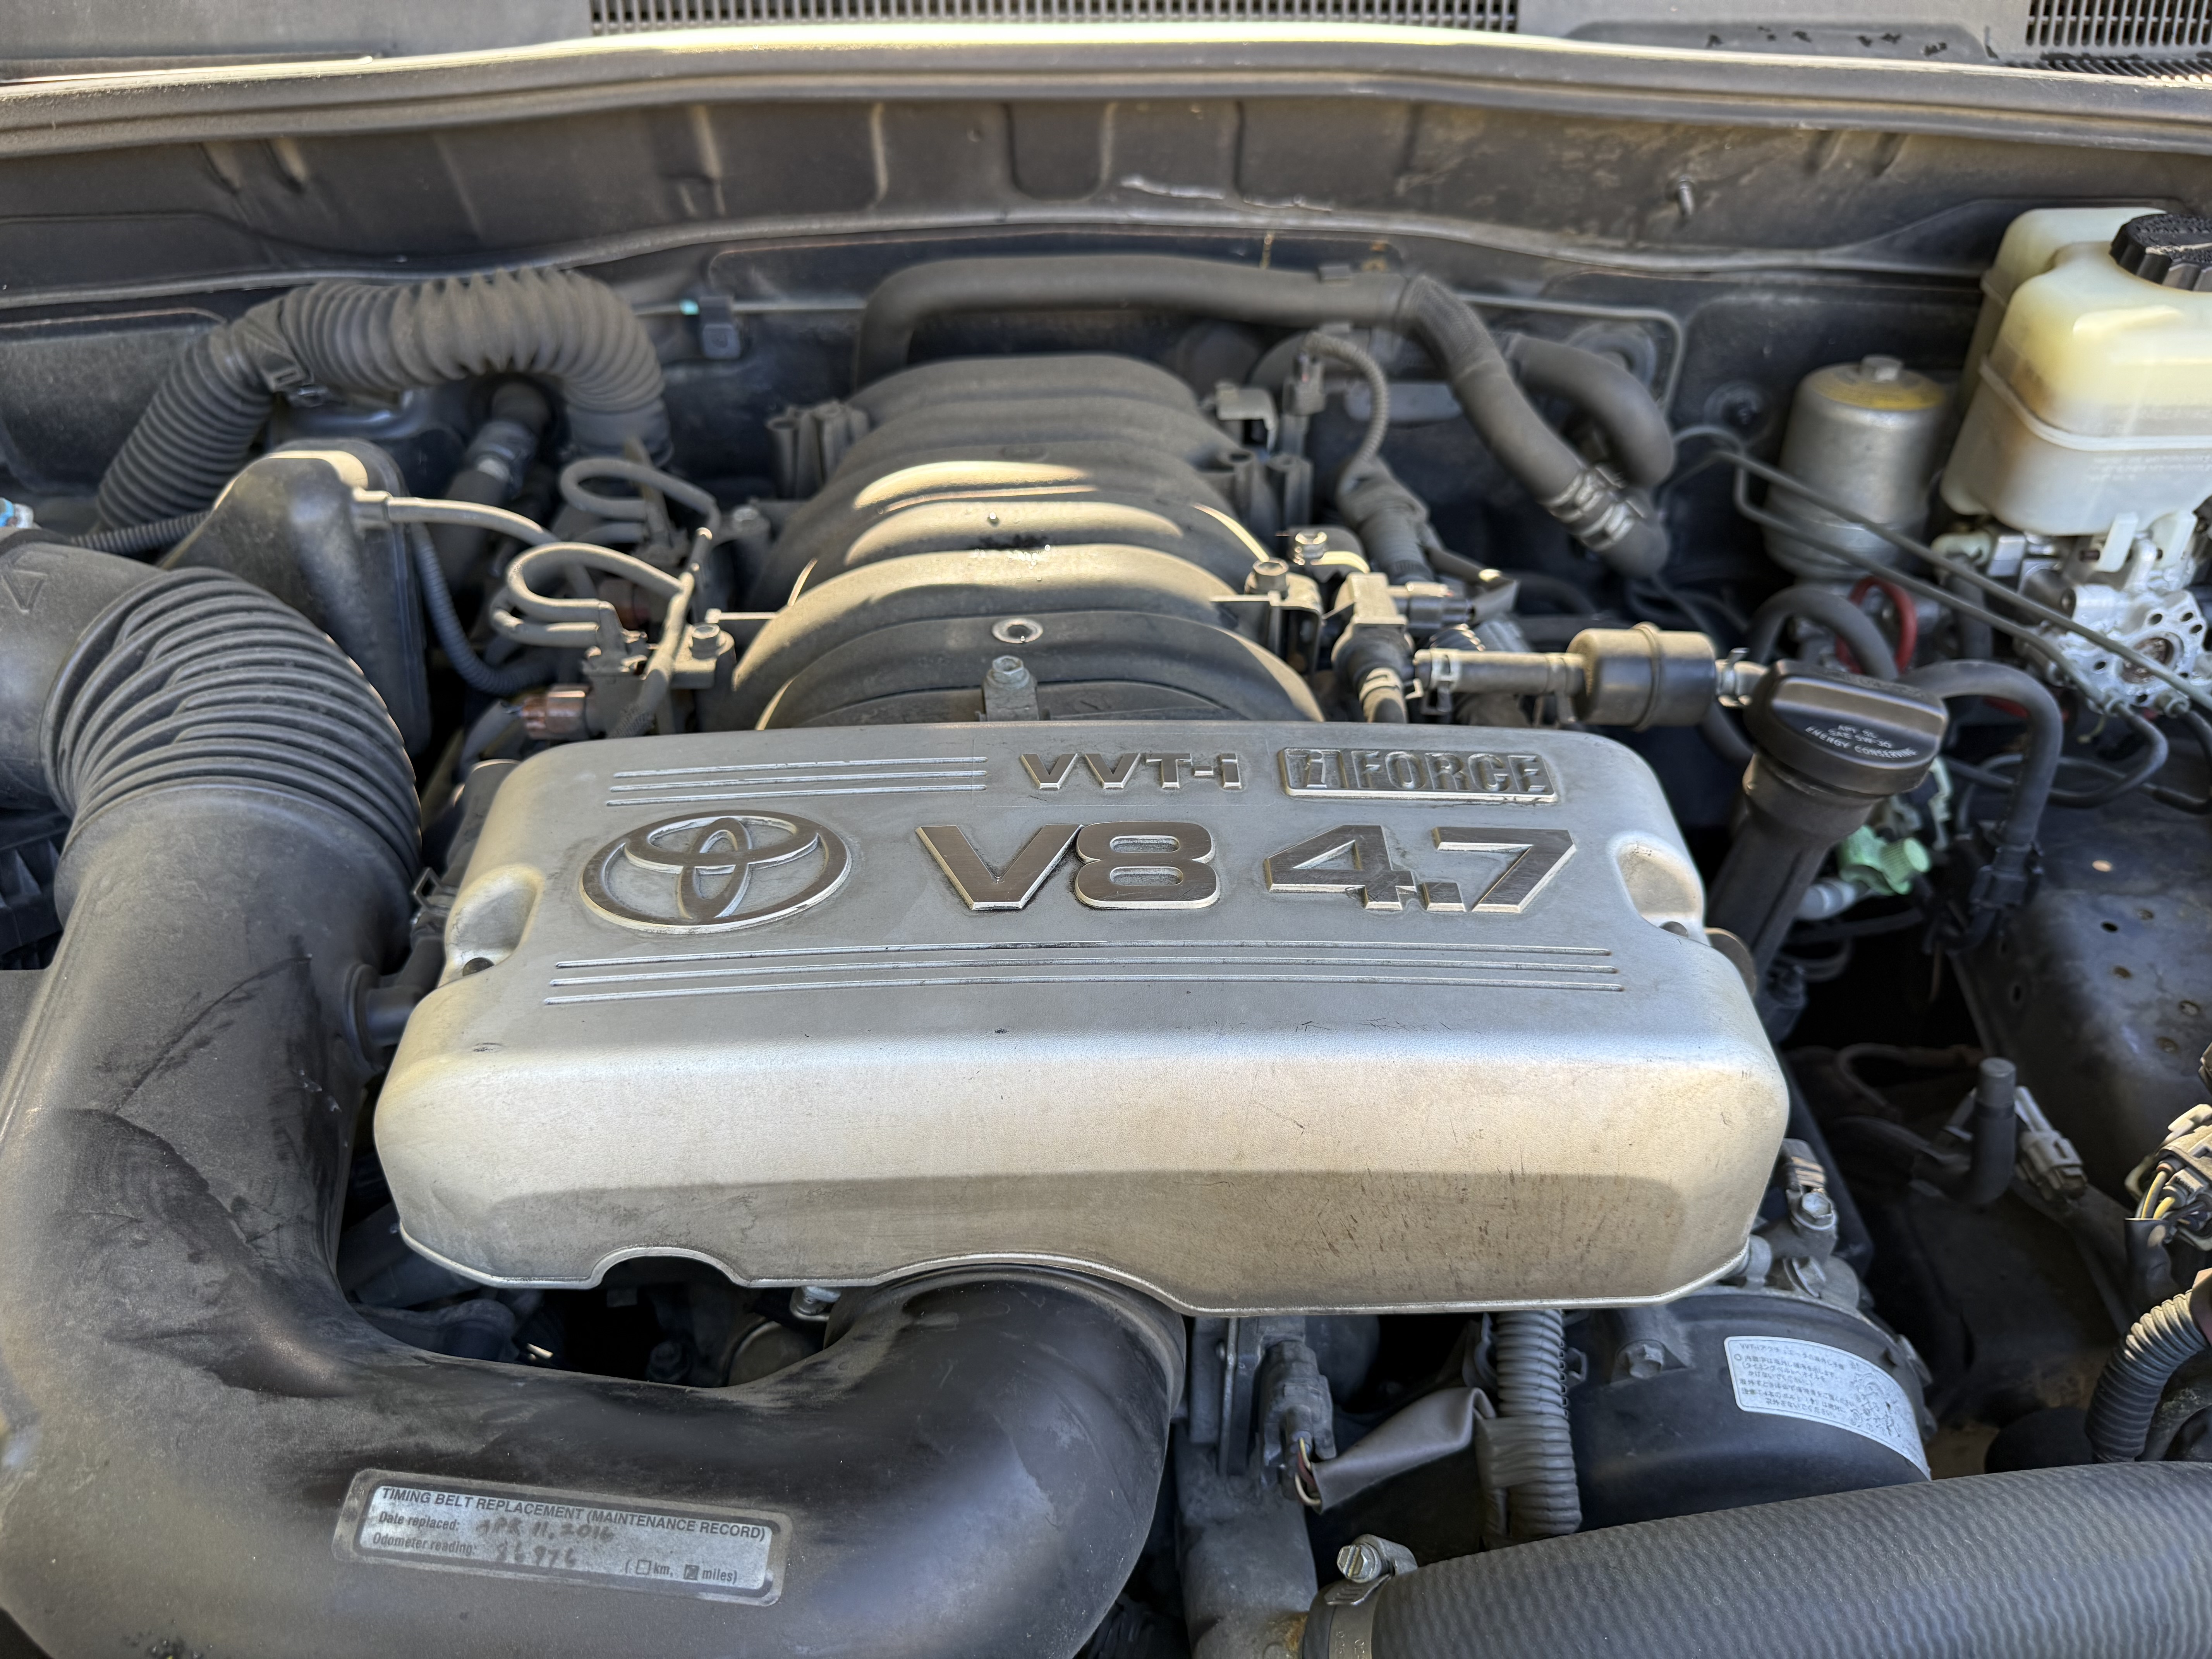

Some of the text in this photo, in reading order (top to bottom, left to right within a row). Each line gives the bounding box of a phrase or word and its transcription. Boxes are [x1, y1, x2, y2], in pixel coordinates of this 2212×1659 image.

[1805, 725, 1918, 758] ENERGY CONSERVING
[915, 821, 1577, 913] V8 4.7
[378, 1511, 461, 1530] Date replaced:
[382, 1487, 766, 1542] TIMING BELT REPLACEMENT (MAINTENANCE RECORD)
[373, 1532, 477, 1557] Odometer reading:
[702, 1569, 738, 1585] miles)
